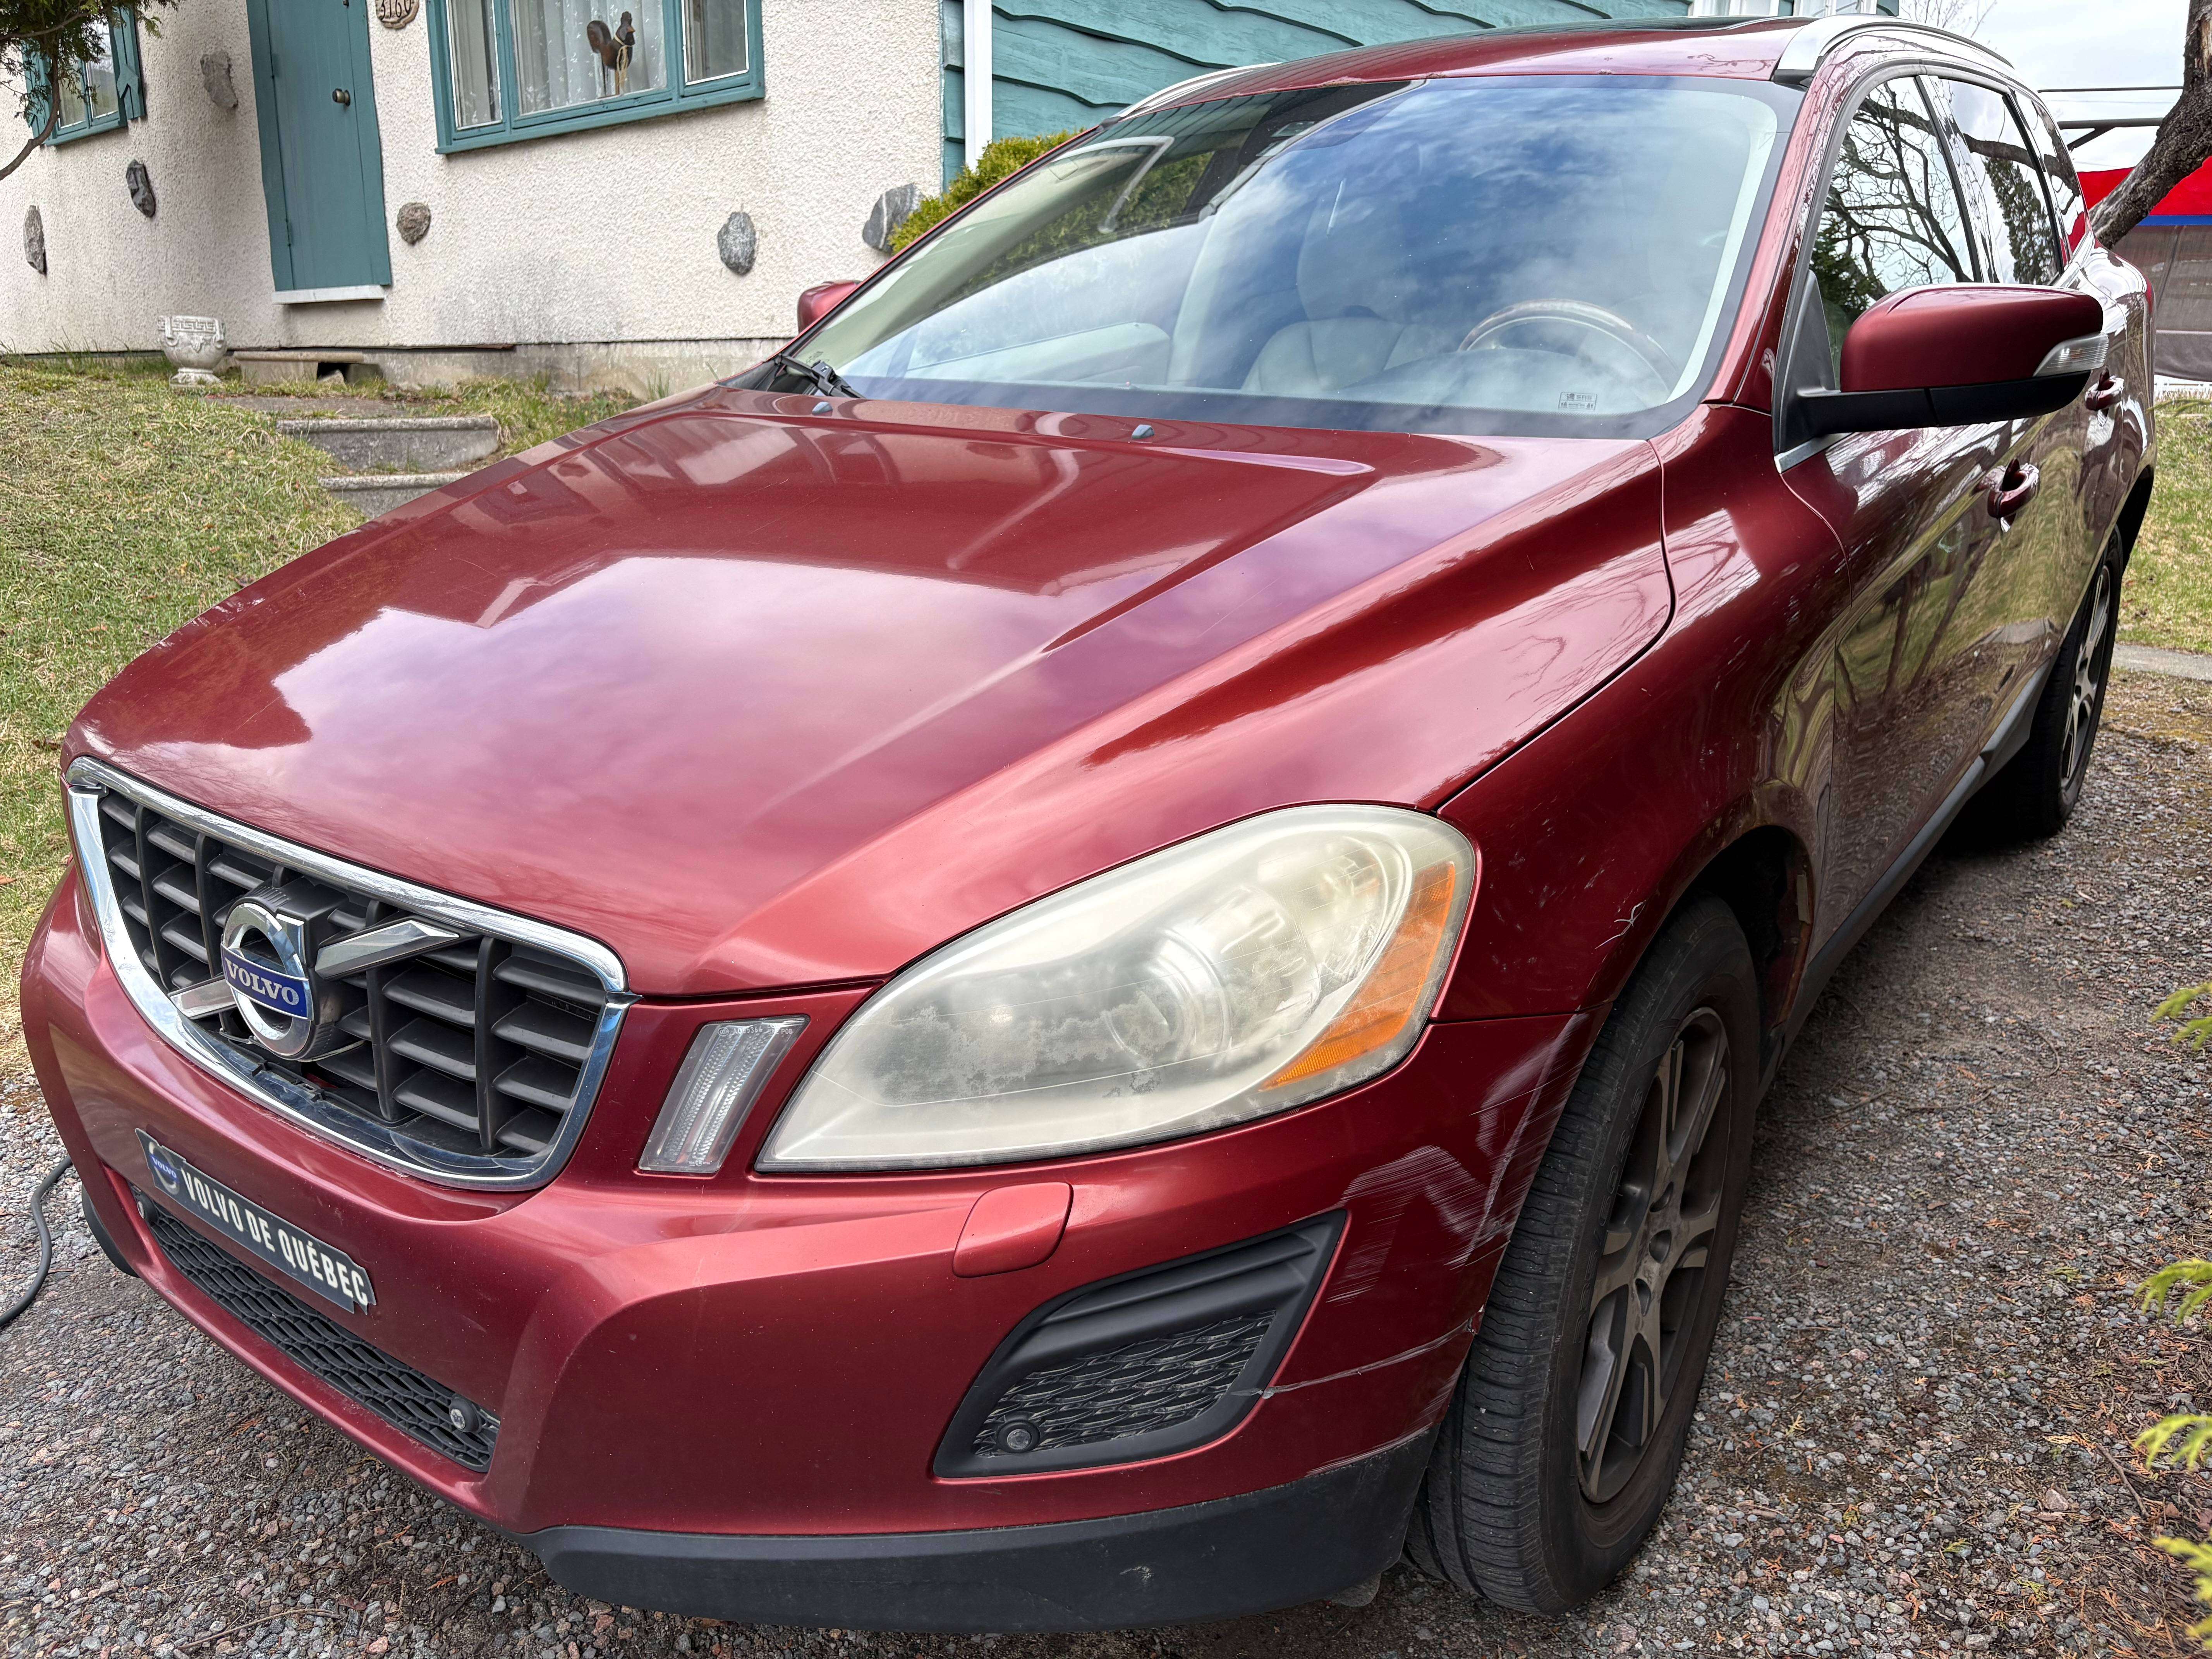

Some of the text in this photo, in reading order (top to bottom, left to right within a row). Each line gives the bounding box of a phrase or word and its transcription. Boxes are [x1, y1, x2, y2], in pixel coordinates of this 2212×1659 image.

[225, 957, 299, 1006] VOLVO
[151, 1156, 177, 1178] VOLVO
[181, 1169, 368, 1306] VOLVO DE QUÉBEC
